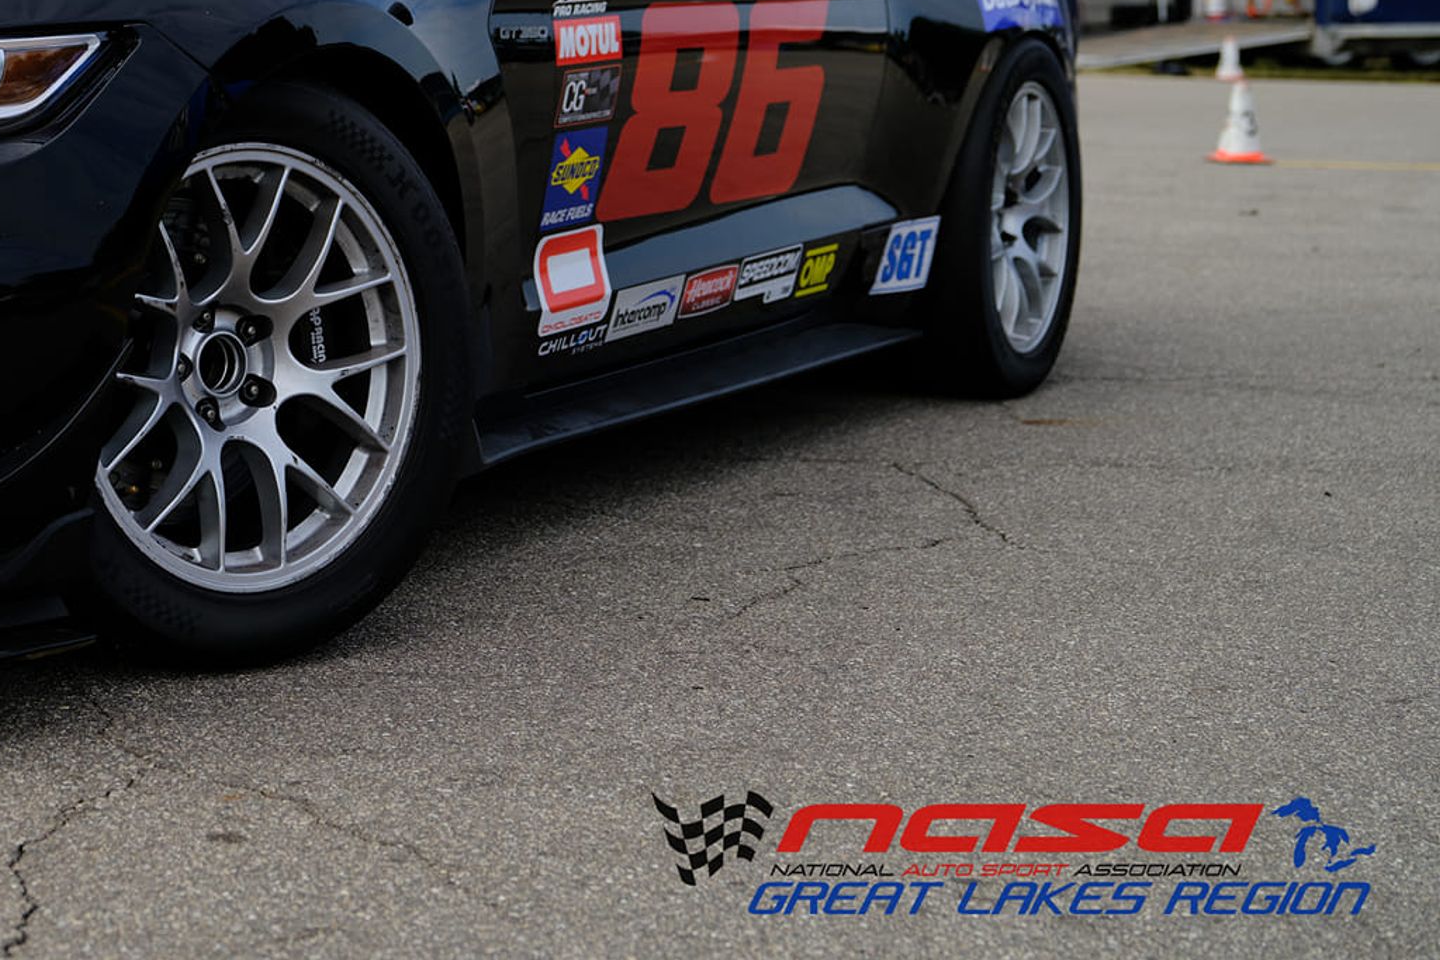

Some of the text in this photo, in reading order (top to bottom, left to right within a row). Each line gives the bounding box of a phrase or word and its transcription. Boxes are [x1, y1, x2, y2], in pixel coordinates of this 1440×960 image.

[553, 1, 608, 17] PRO RACING
[559, 22, 620, 59] MOTUL
[551, 158, 599, 183] SUNOCO
[541, 203, 594, 226] RACE FUELS
[799, 253, 836, 288] OMP
[613, 302, 668, 328] Intercomp
